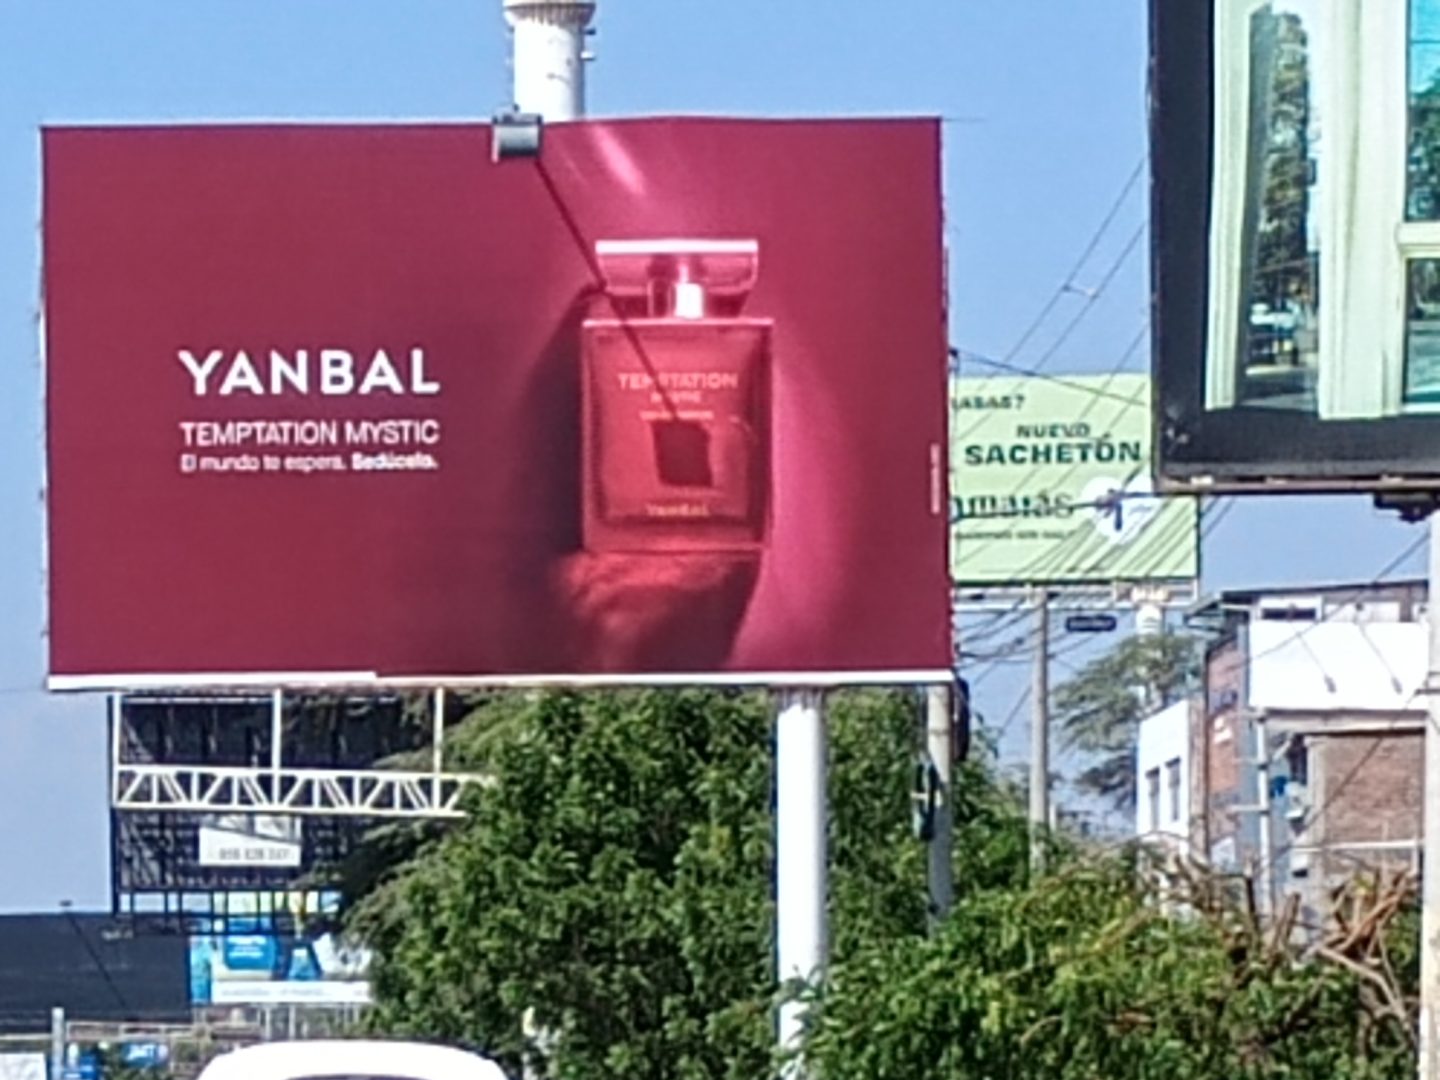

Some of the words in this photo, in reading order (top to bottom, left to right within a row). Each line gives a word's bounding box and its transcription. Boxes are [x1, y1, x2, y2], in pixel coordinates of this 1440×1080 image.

[177, 348, 441, 396] YANBAL
[179, 421, 338, 446] TEMPTATION
[345, 420, 440, 445] MYSTIC
[1017, 423, 1091, 438] NUEVO
[964, 433, 1142, 465] SACHETÓN
[199, 454, 260, 471] mundo
[263, 455, 281, 470] te
